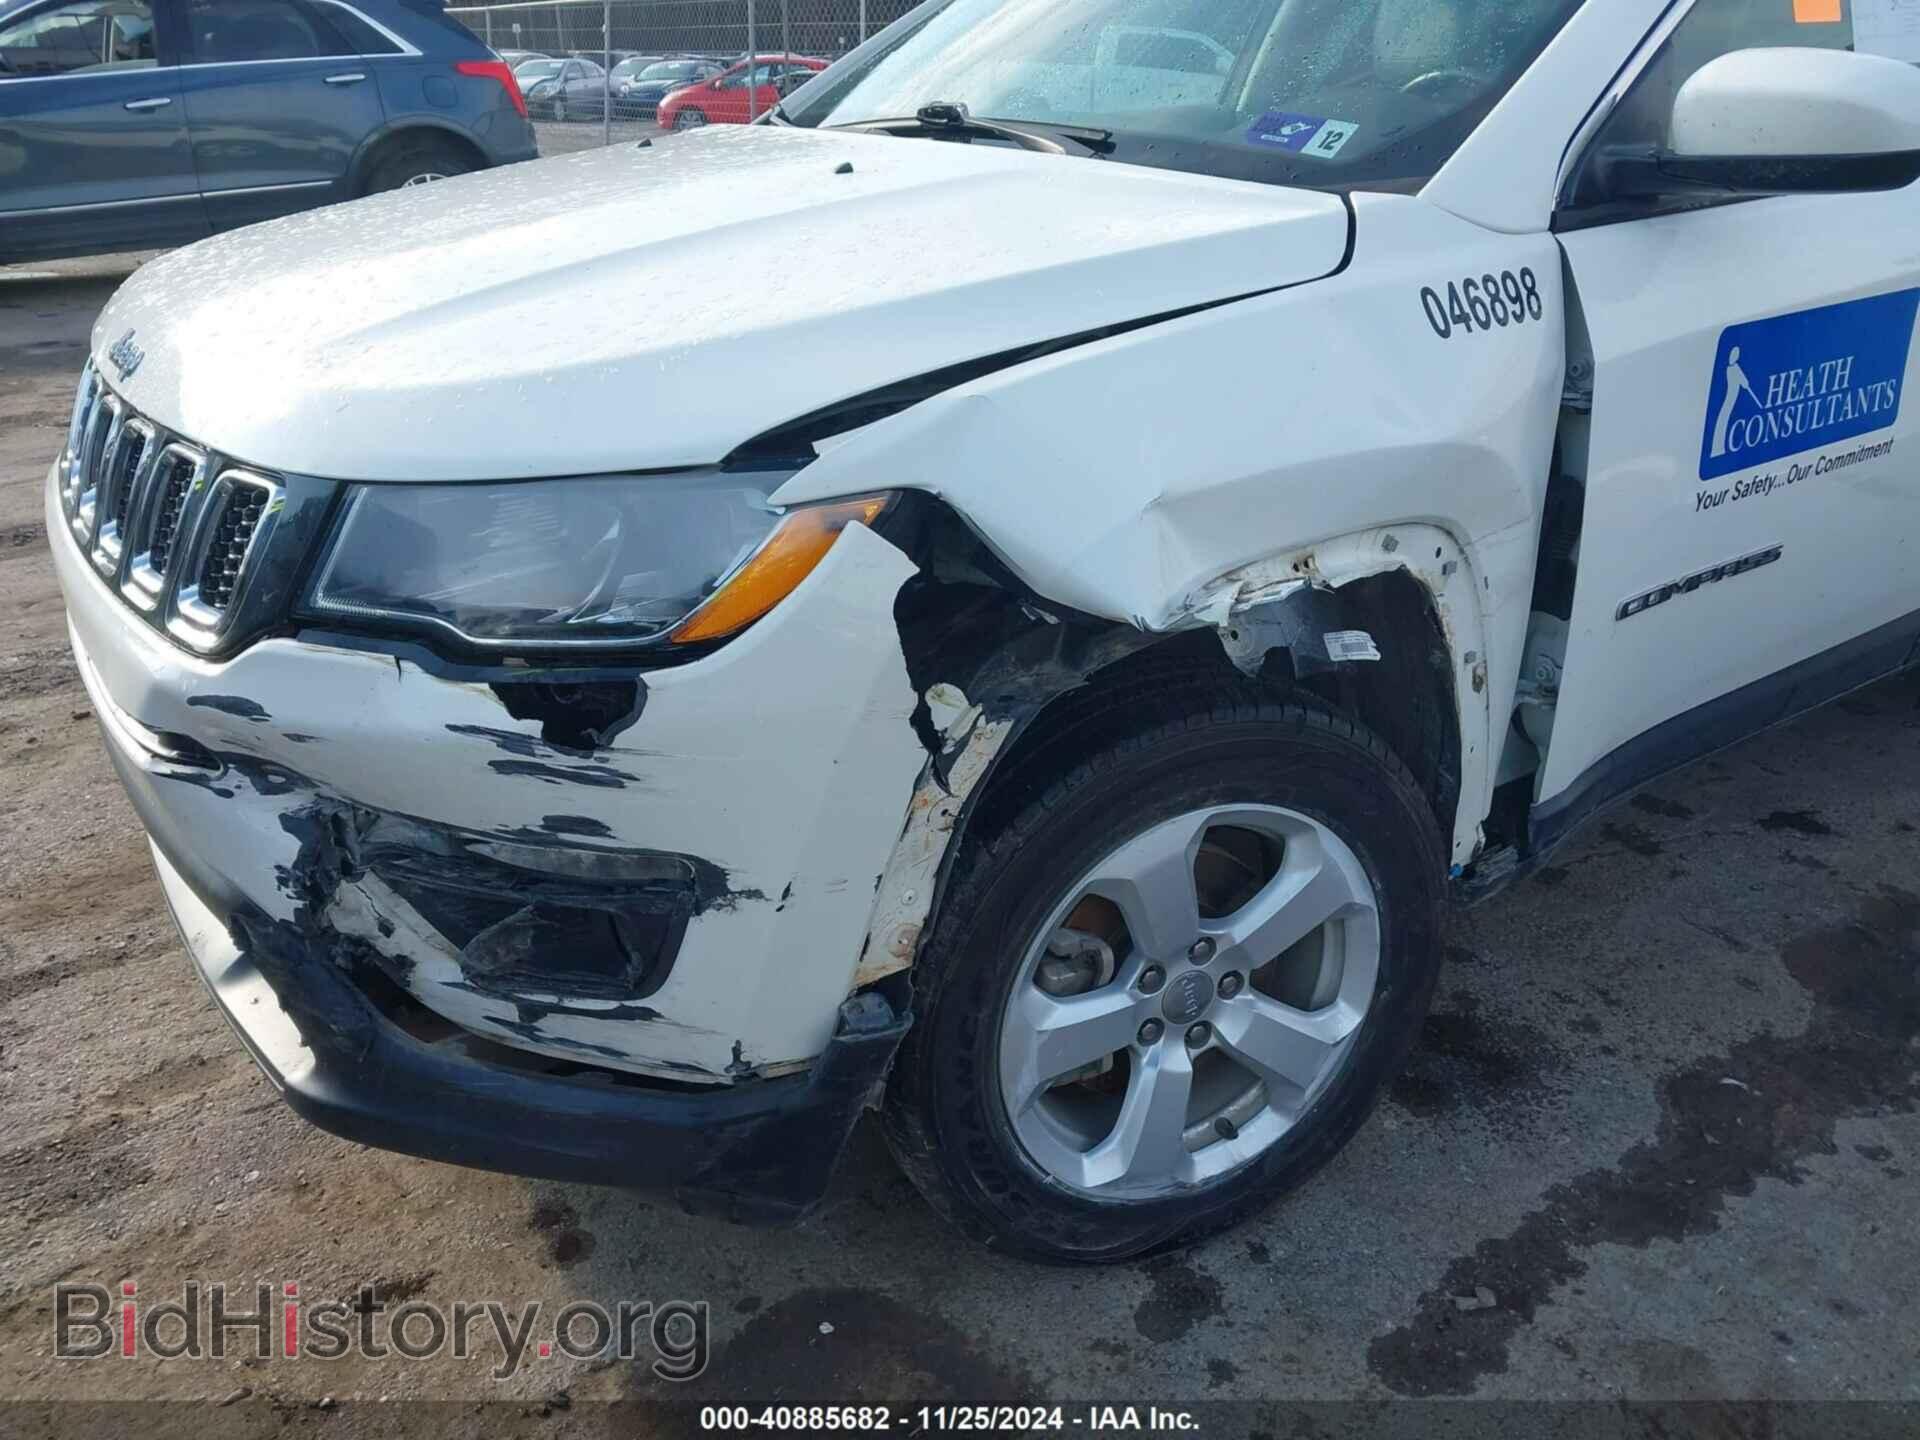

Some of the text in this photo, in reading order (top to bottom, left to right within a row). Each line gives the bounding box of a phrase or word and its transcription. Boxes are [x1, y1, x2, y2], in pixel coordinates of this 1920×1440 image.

[1317, 130, 1344, 150] 12
[1420, 266, 1542, 339] 046898
[1728, 378, 1896, 453] CONSULTANTS
[1764, 355, 1855, 408] HEATH
[1695, 487, 1730, 512] Your
[1815, 437, 1895, 476] Commitment
